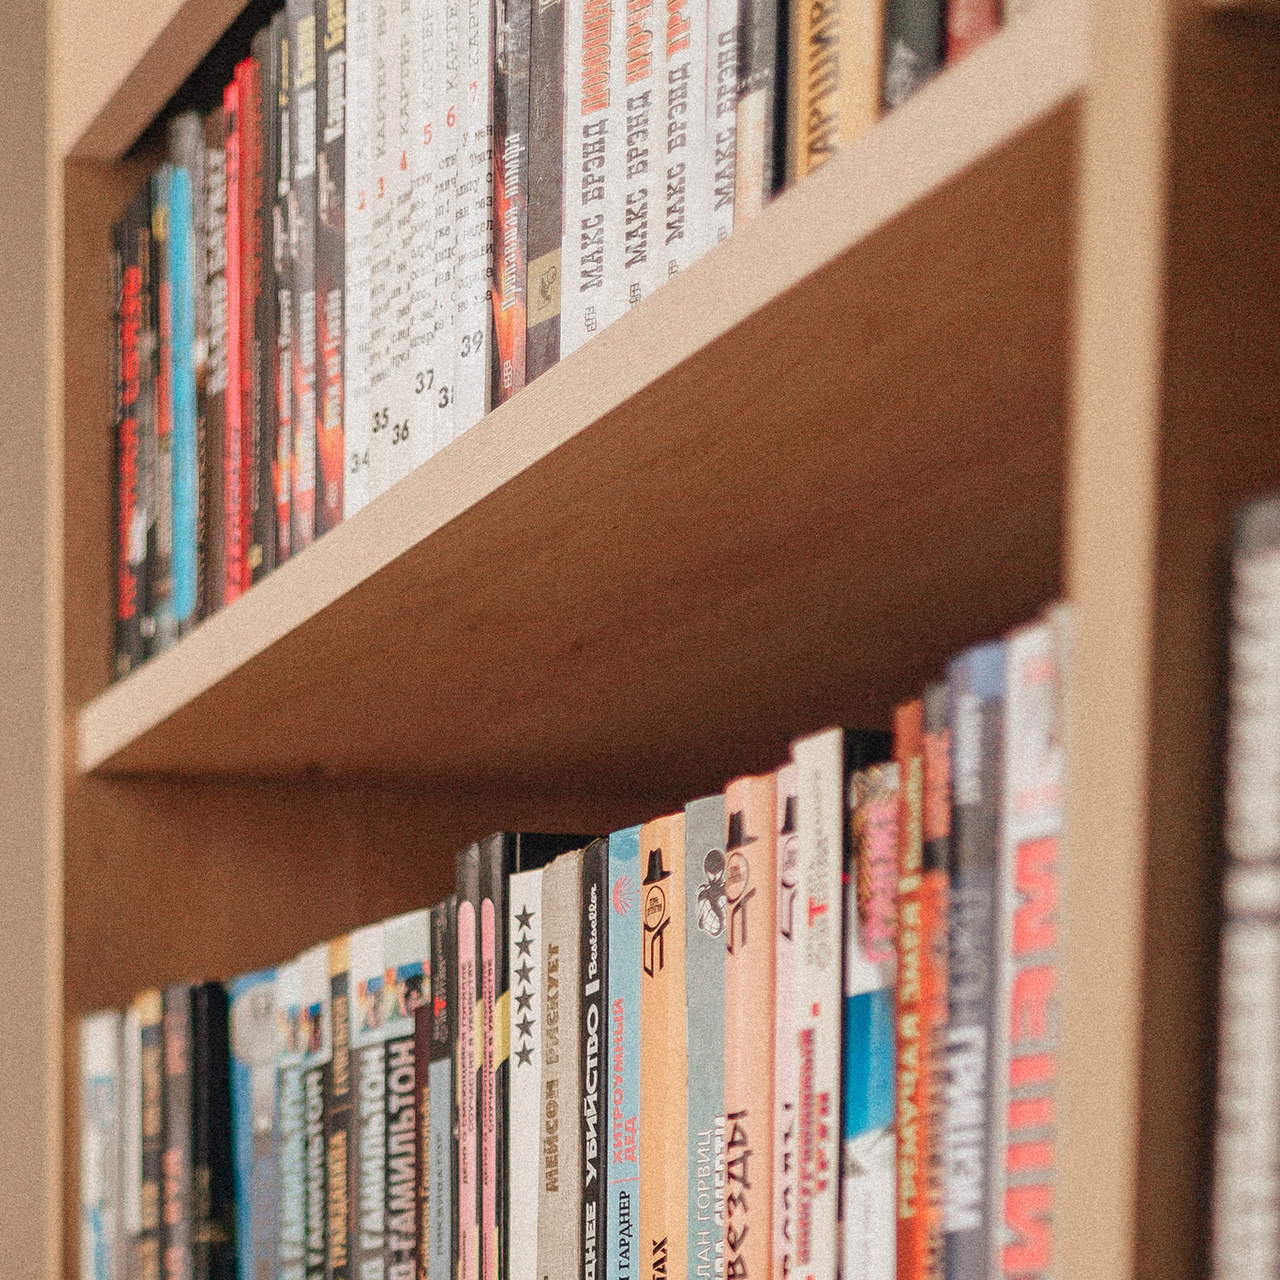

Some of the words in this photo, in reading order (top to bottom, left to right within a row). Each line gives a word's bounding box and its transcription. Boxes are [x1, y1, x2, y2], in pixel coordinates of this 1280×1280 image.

[468, 80, 479, 103] 7
[667, 62, 691, 155] БРЭНД
[716, 26, 739, 120] БРЭНД
[422, 122, 434, 146] 5
[445, 105, 457, 128] 6
[626, 90, 653, 180] БРЭНД
[502, 132, 526, 198] нимфа
[582, 117, 610, 205] БРЭНД
[714, 126, 735, 212] МАКС
[624, 187, 649, 270] МАКС
[665, 162, 687, 246] МАКС
[581, 214, 605, 293] МАКС
[415, 368, 435, 395] 37
[460, 329, 484, 359] 39
[371, 407, 390, 435] 35
[391, 419, 410, 446] 36
[588, 883, 598, 980] Bestseller
[546, 943, 560, 1066] РИСКУЕТ
[583, 1004, 599, 1186] УБИЙСТВО
[611, 997, 624, 1165] ХИТРОУМНЫЙ
[359, 1046, 386, 1250] ГАМИЛЬТОН
[389, 1038, 415, 1252] ГАМИЛЬТОН
[543, 1080, 559, 1192] МЕЙСОН
[624, 1116, 637, 1163] ДЕД
[696, 1128, 713, 1222] ГОРВИЦ
[618, 1190, 633, 1270] ГАРДНЕР
